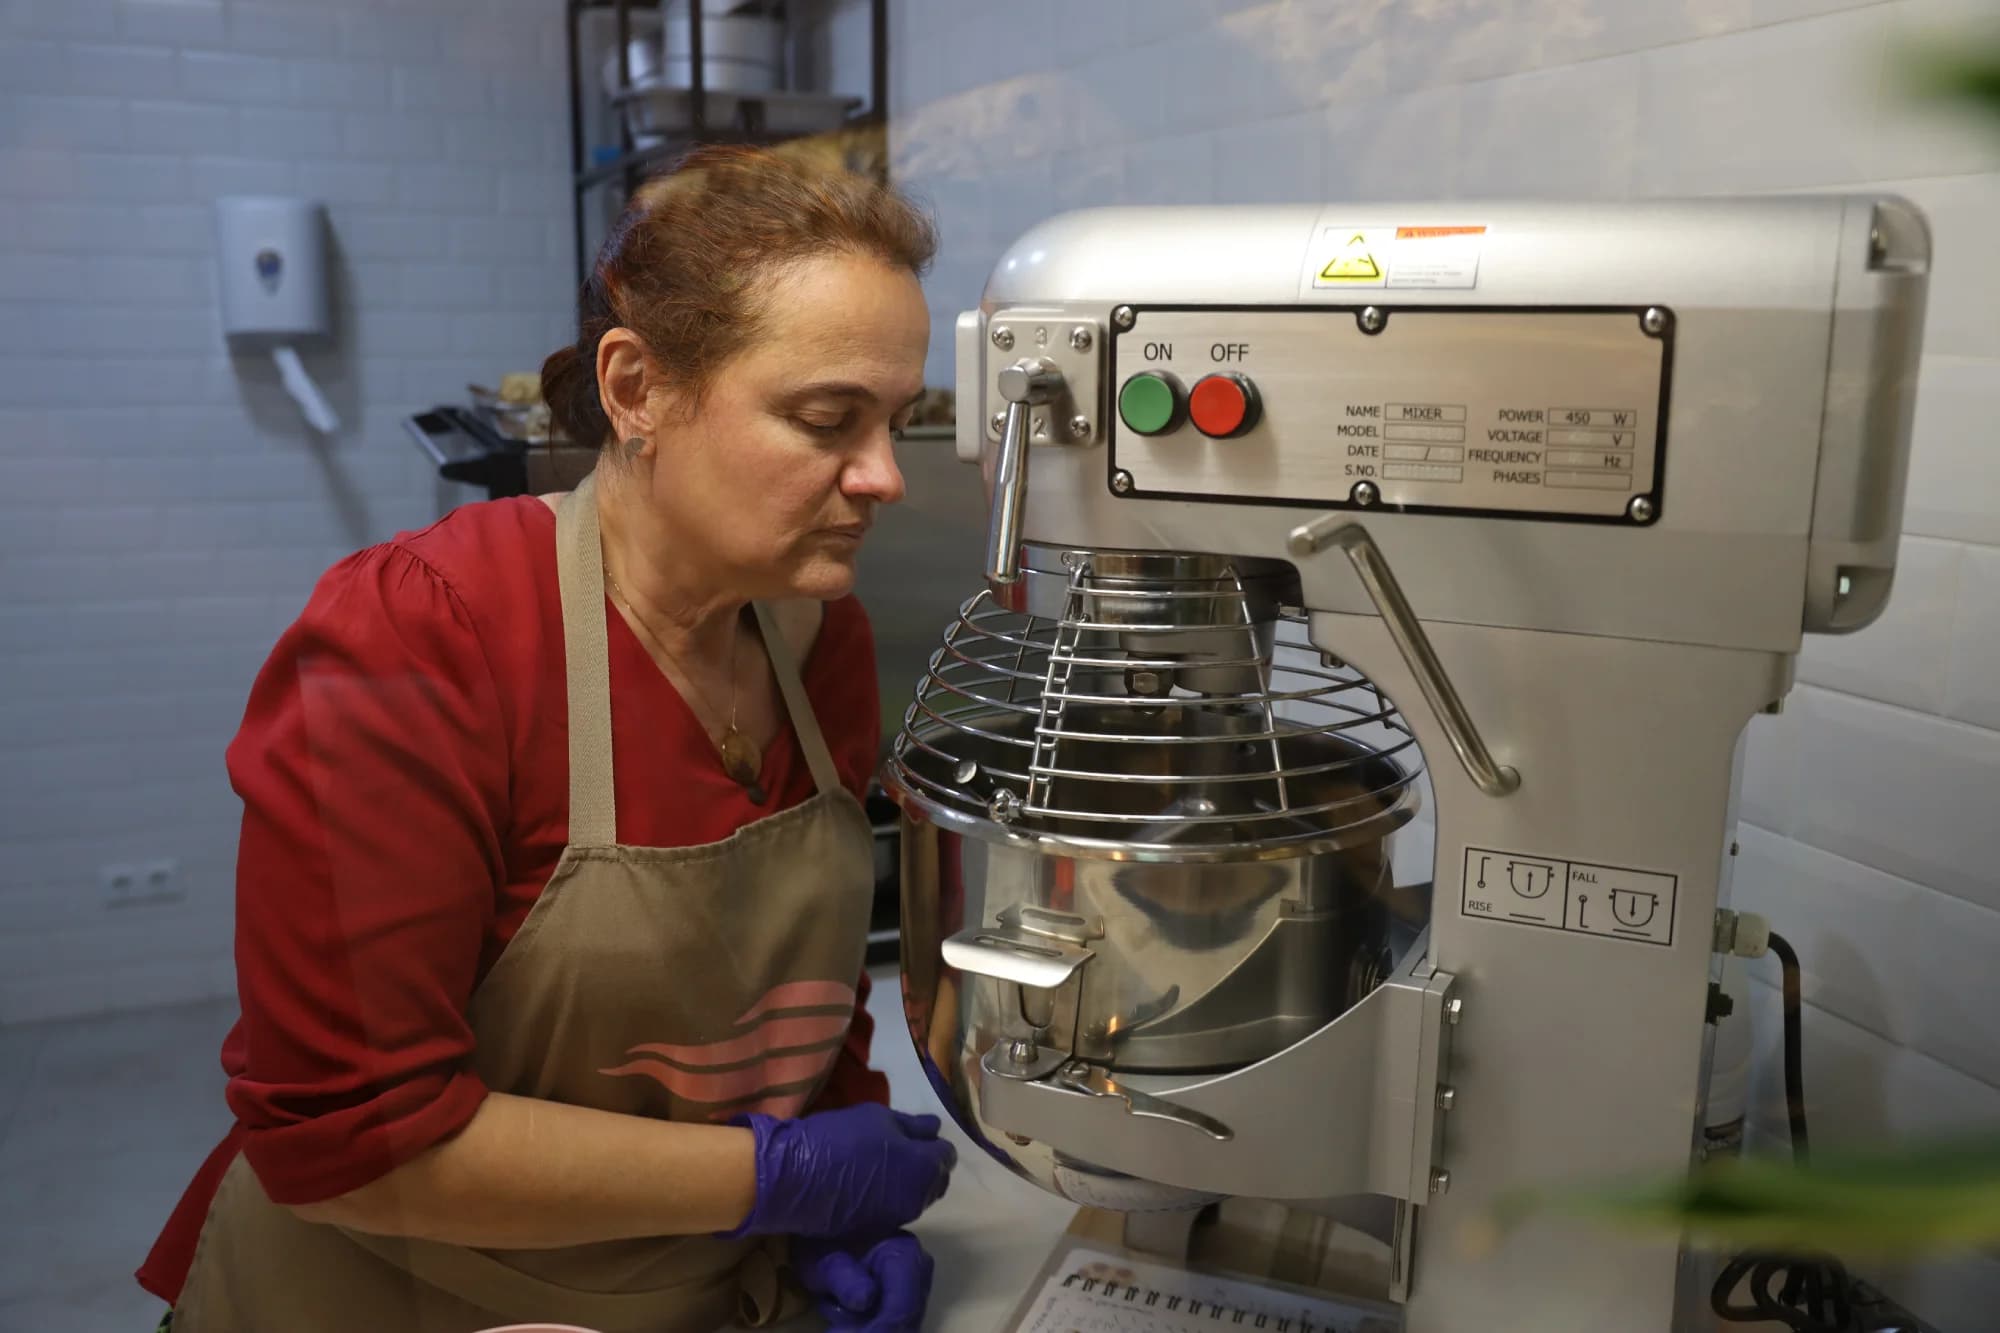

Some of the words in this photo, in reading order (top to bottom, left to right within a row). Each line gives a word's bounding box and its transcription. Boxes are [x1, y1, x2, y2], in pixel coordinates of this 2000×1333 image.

[1144, 342, 1172, 361] ON
[1210, 343, 1249, 362] OFF
[1346, 405, 1380, 418] NAME
[1403, 407, 1442, 420] MIXER
[1499, 409, 1544, 423] POWER
[1565, 412, 1591, 425] 450
[1613, 413, 1628, 426] W
[1034, 418, 1046, 439] 2
[1337, 424, 1379, 438] MODEL
[1488, 429, 1542, 443] VOLTAGE
[1612, 433, 1622, 447] V
[1347, 444, 1379, 458] DATE
[1468, 449, 1542, 464] FREQUENCY
[1604, 455, 1621, 468] Hz
[1345, 464, 1378, 478] S.NO.
[1493, 470, 1541, 485] PHASES
[1572, 870, 1599, 885] FALL
[1468, 899, 1493, 913] RISE
